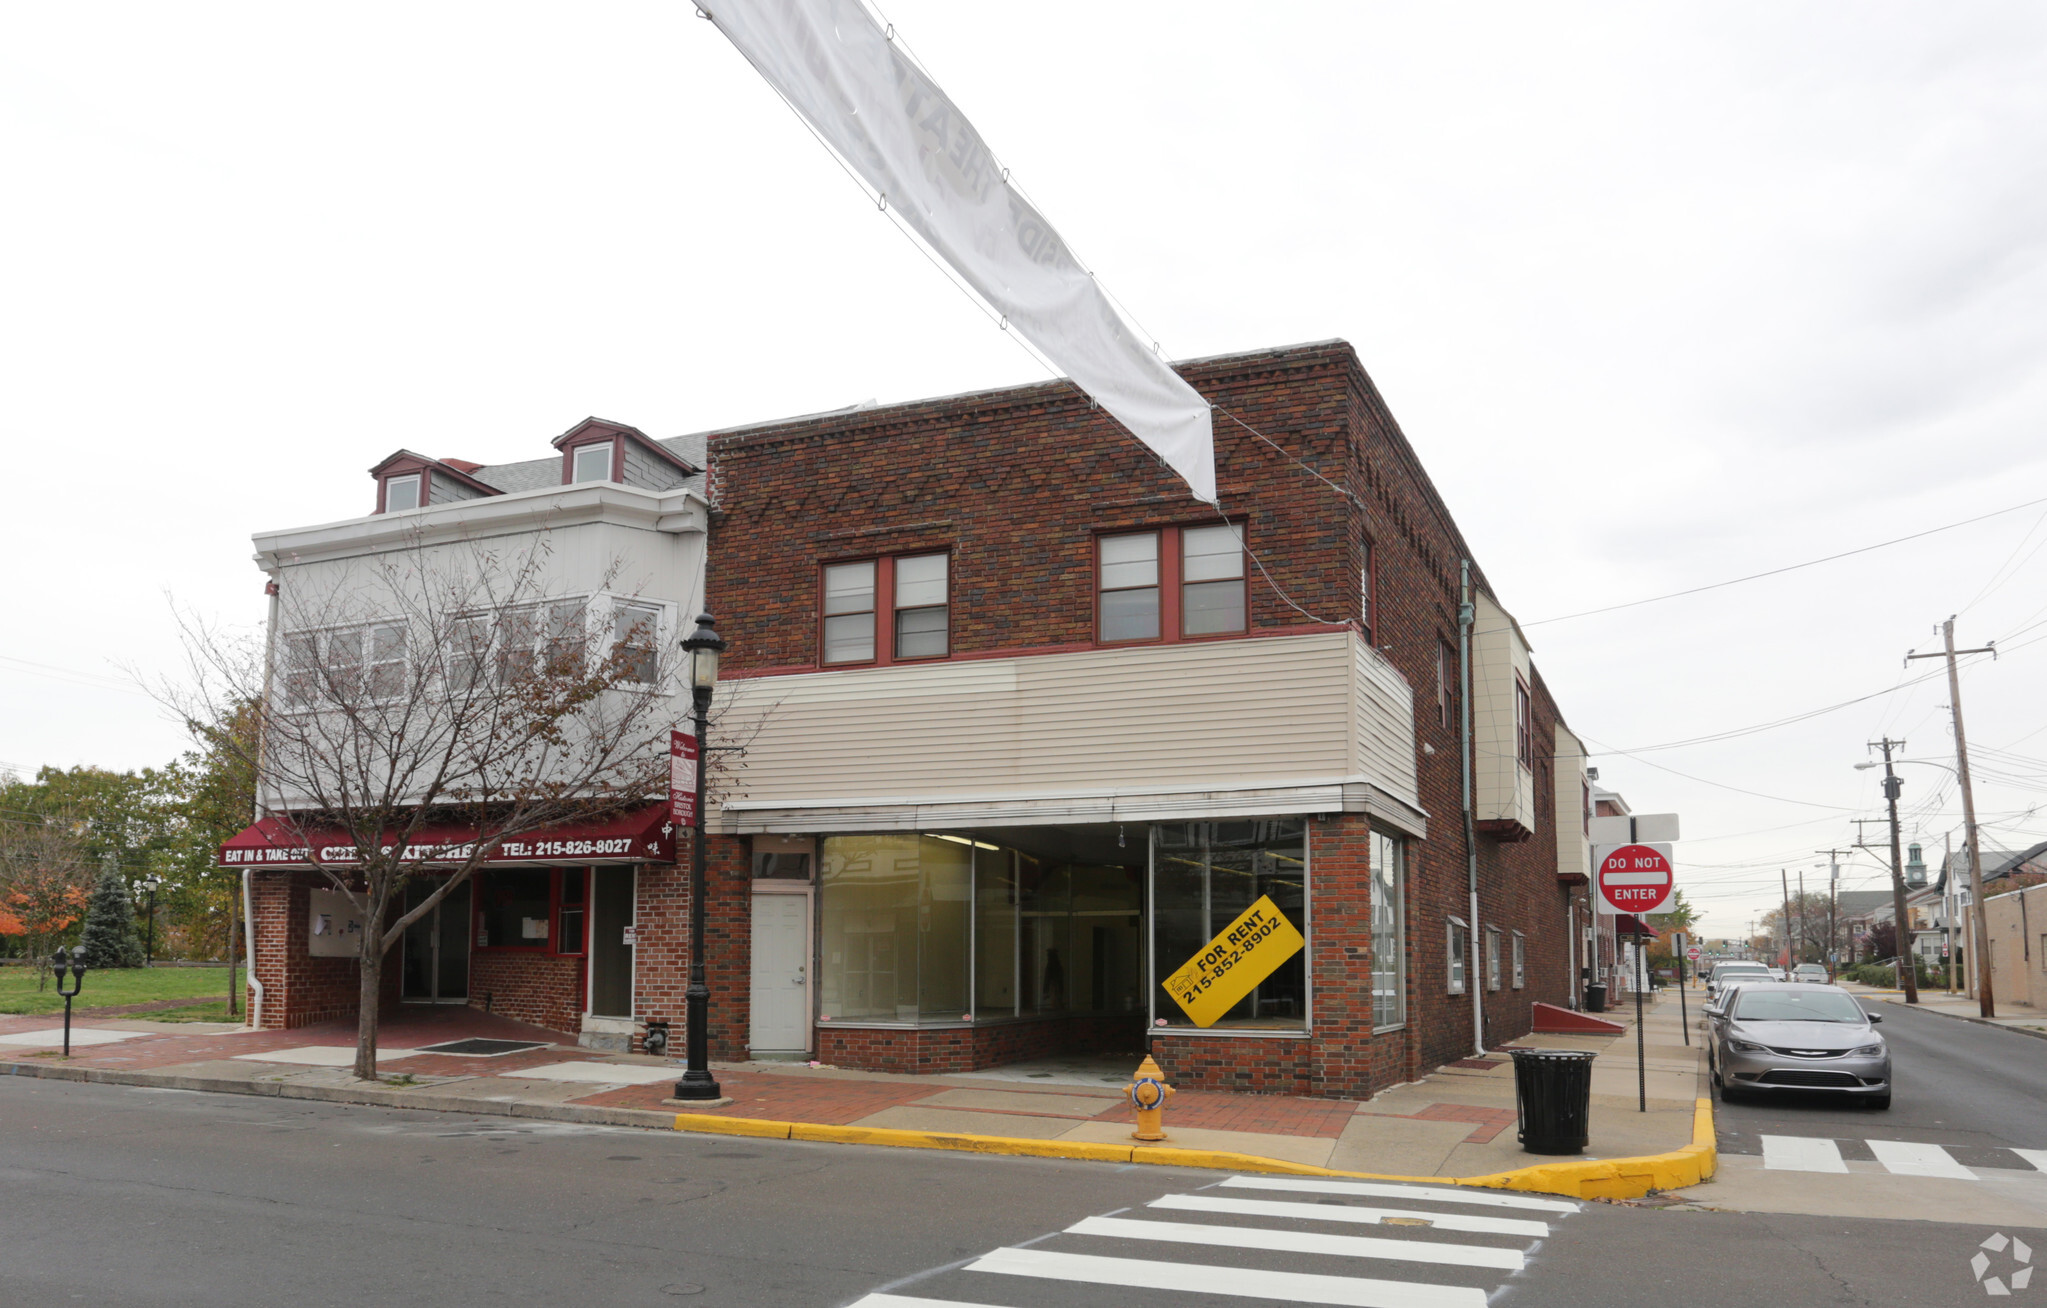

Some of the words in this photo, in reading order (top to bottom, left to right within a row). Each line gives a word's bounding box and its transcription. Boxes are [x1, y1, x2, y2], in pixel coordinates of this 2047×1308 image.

[673, 801, 692, 811] BRISTOL
[672, 808, 693, 818] BOROUGH
[501, 842, 532, 857] TEL:
[535, 838, 632, 856] 215-826-8027
[225, 849, 243, 863] EAT
[244, 849, 254, 862] IN
[256, 849, 263, 862] &
[265, 848, 289, 861] TAKE
[290, 848, 309, 861] OUT
[1608, 857, 1627, 869] DO
[1634, 857, 1661, 869] NOT
[1614, 888, 1657, 900] ENTER
[1196, 944, 1228, 973] FOR
[1226, 909, 1265, 946] RENT
[1183, 916, 1281, 1004] 215-852-8902
